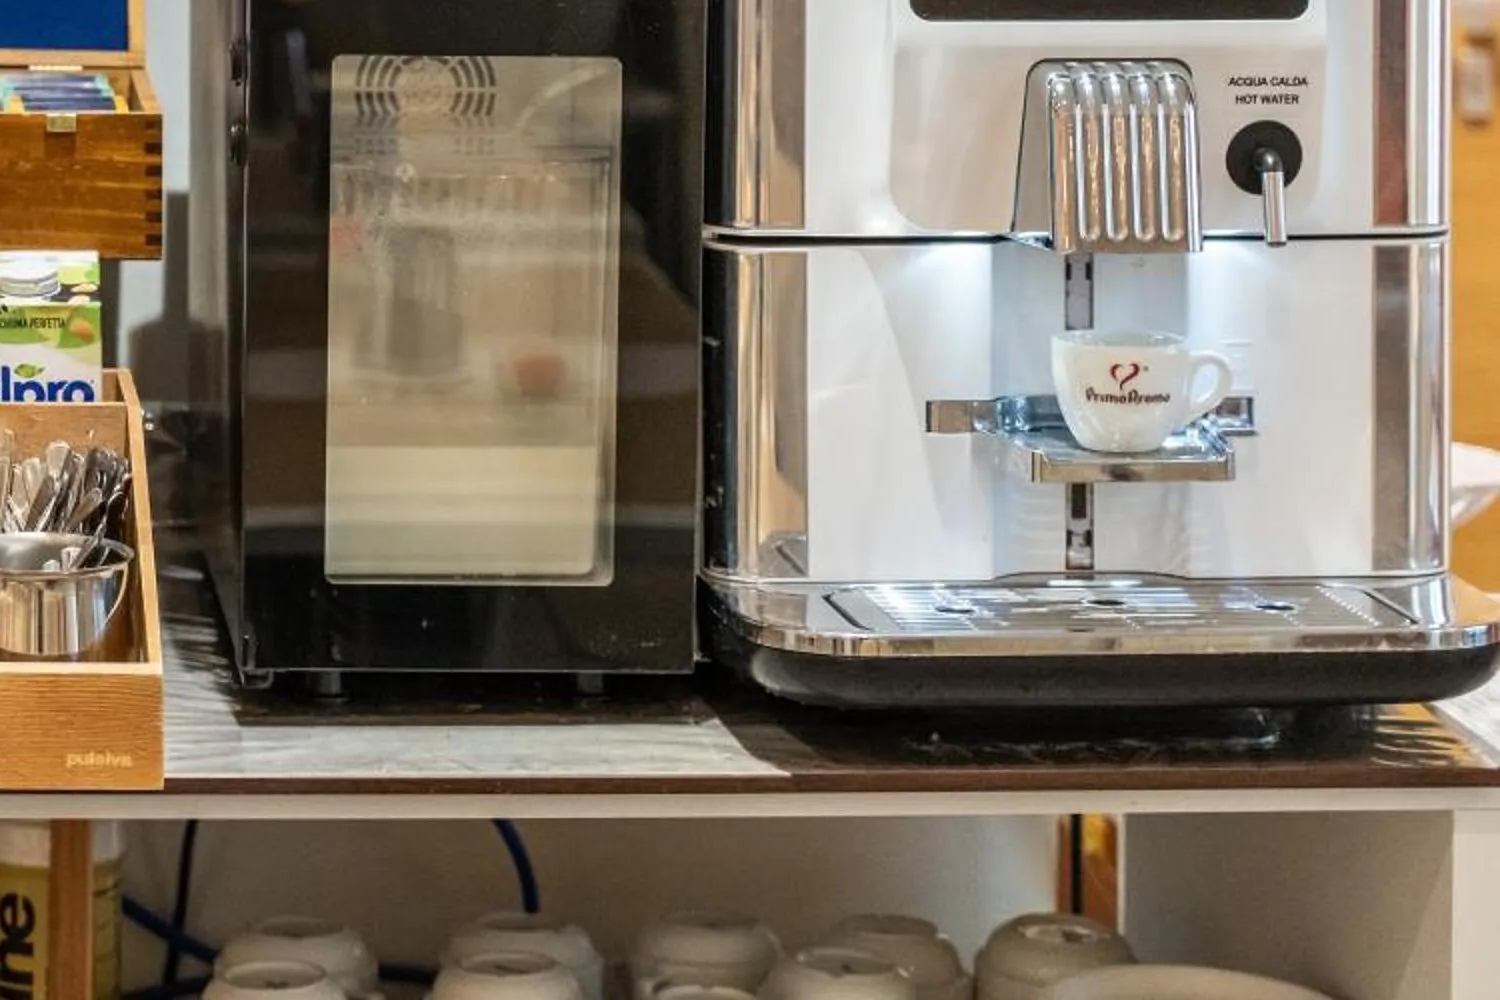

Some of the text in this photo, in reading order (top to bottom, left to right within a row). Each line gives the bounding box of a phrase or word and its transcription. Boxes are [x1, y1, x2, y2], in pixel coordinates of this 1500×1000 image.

[1228, 76, 1308, 87] ACQUA CALDA
[1235, 93, 1299, 105] HOT WATER
